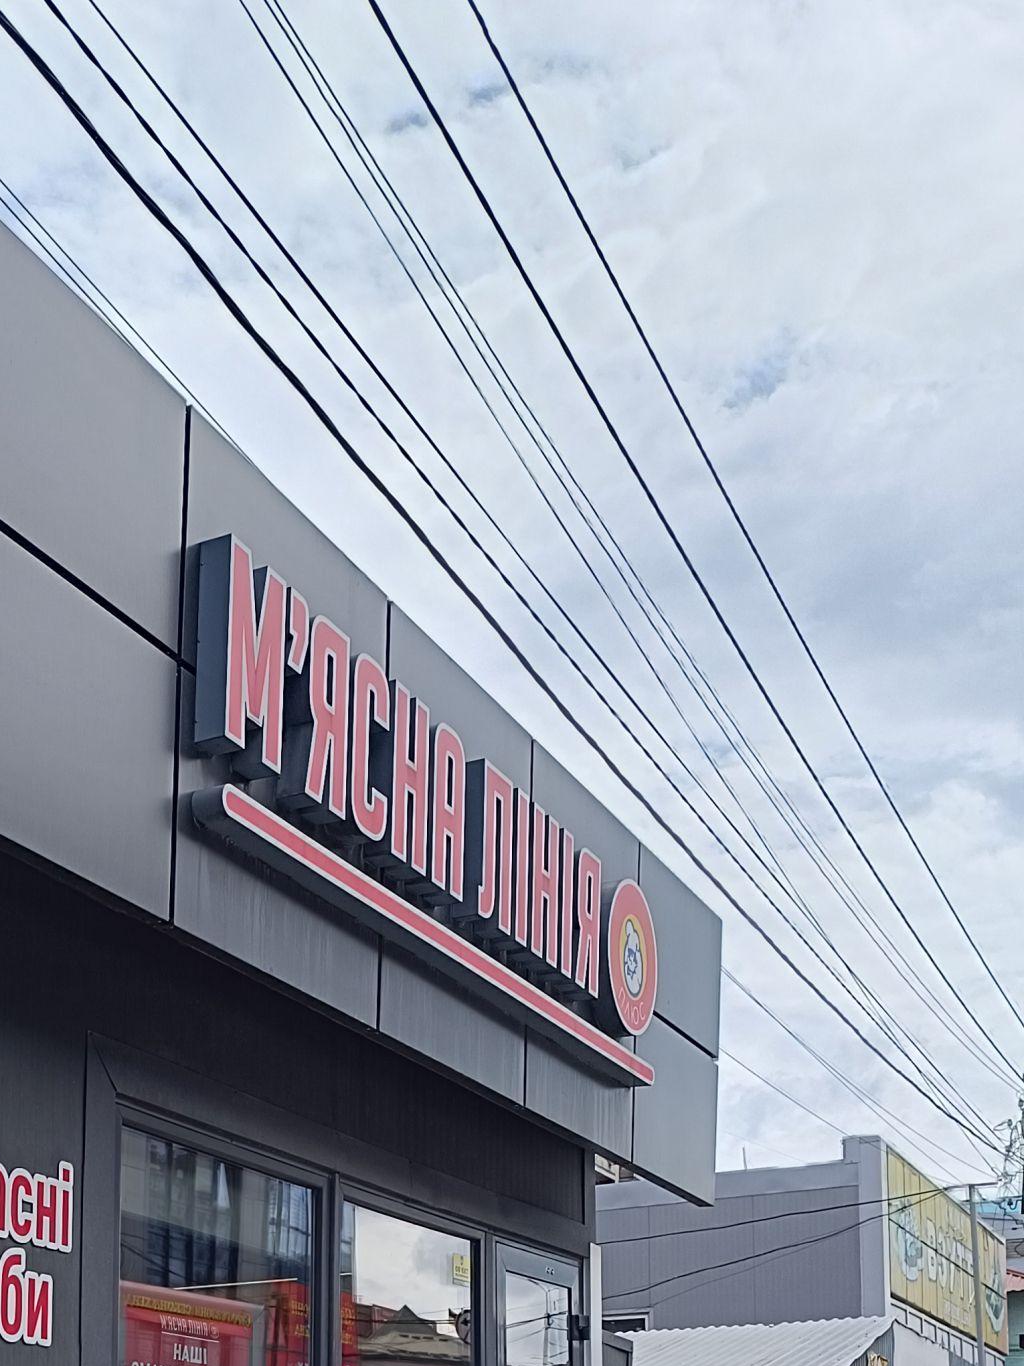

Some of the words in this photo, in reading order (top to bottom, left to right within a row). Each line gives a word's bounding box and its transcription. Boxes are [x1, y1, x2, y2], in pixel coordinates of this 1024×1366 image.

[224, 534, 466, 902] М'ЯСНА
[478, 758, 602, 999] ЛІНІЯ
[173, 1344, 208, 1365] НАШІ
